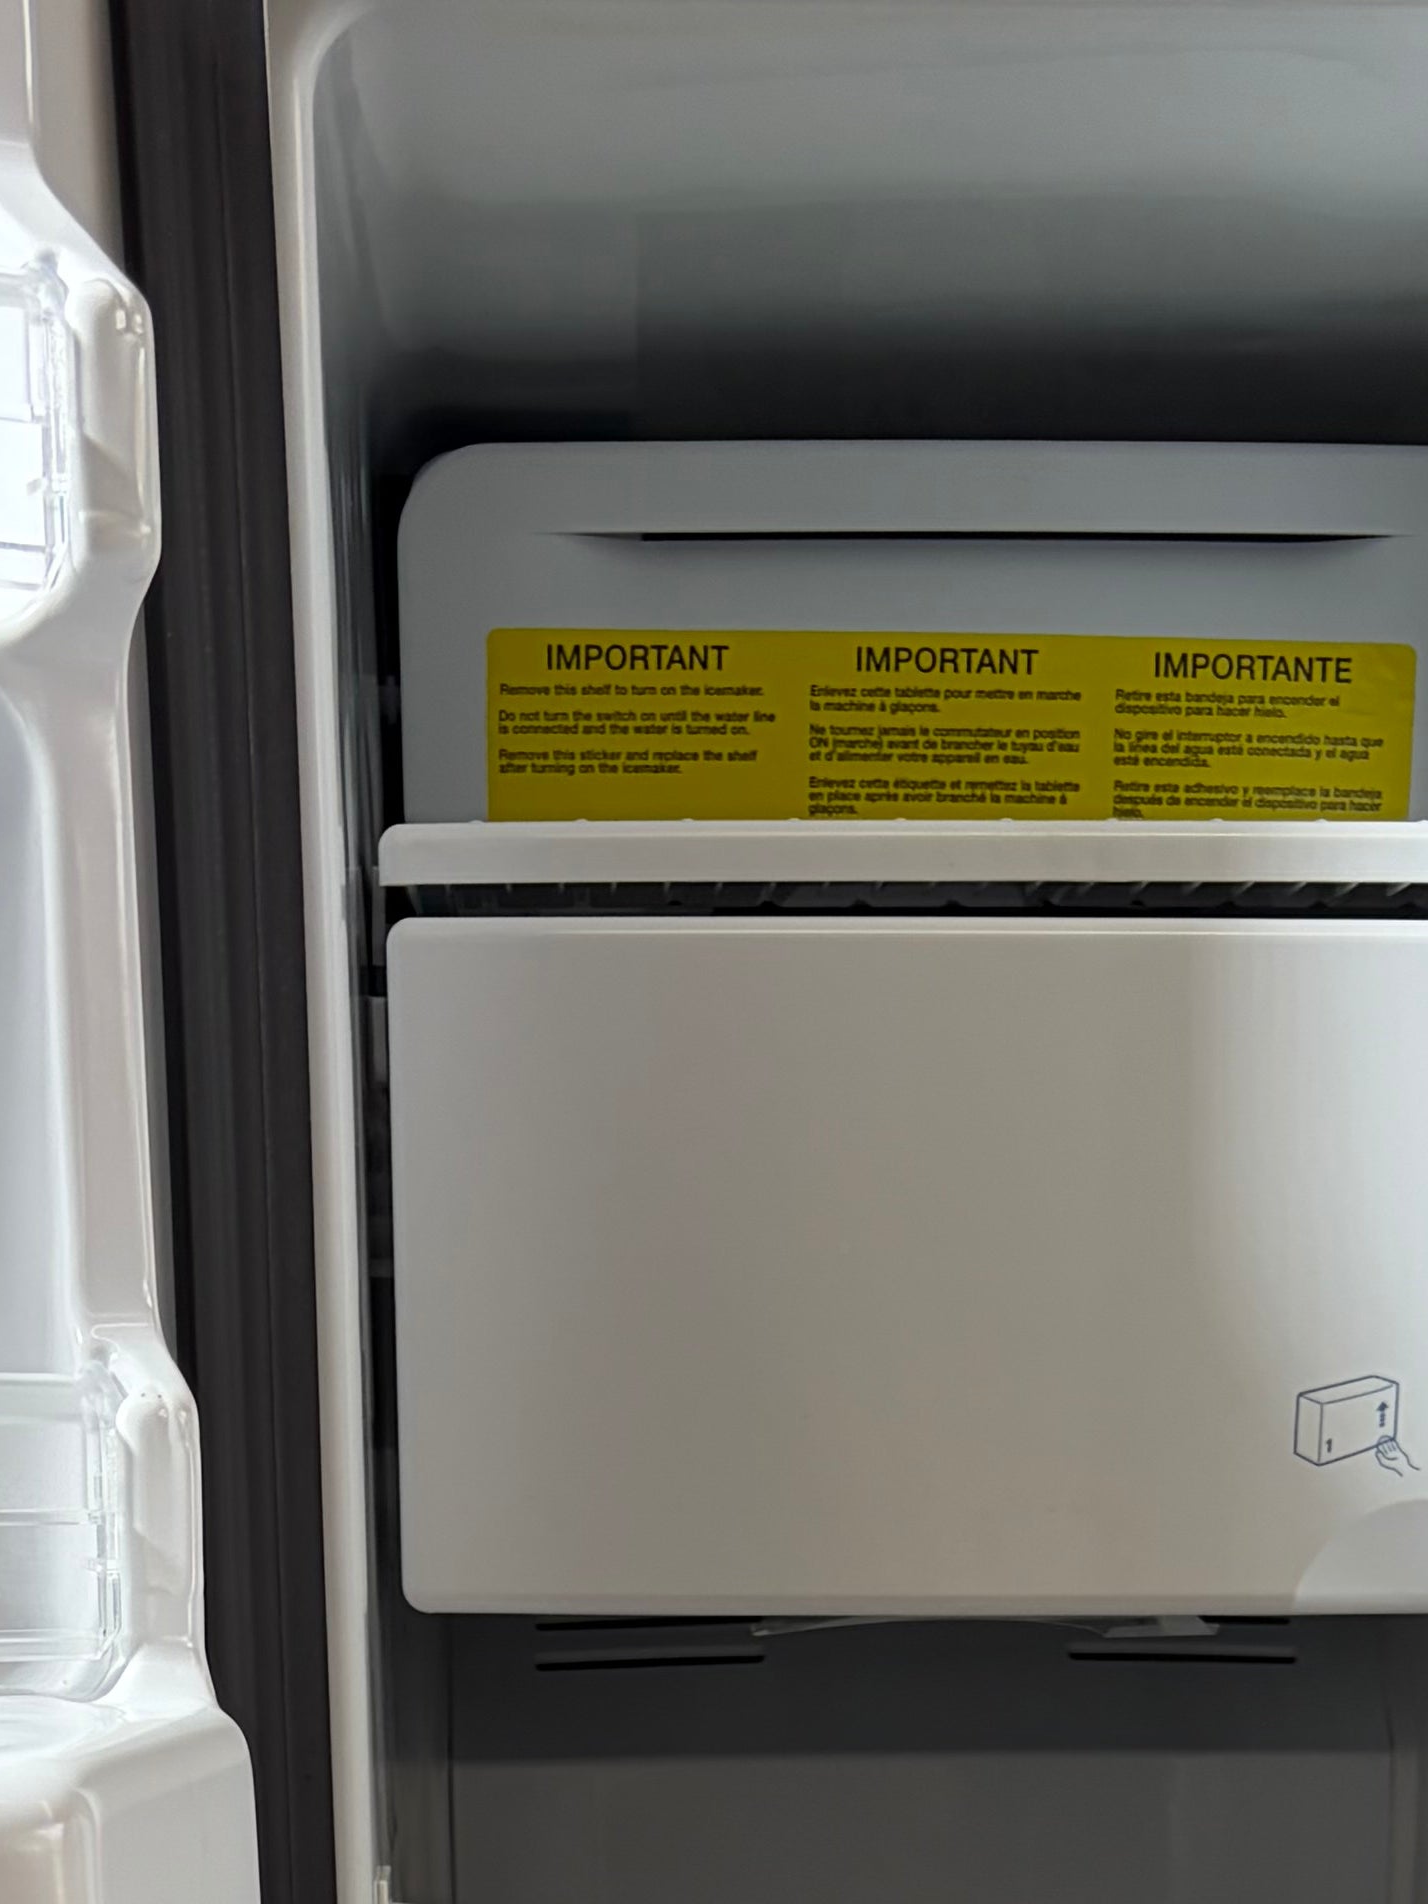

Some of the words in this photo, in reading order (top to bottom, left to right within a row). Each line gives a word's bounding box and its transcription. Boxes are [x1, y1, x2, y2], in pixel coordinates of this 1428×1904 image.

[547, 644, 729, 671] IMPORTANT
[856, 646, 1039, 674] IMPORTANT
[1155, 652, 1352, 683] IMPORTANTE
[500, 684, 550, 695] Remove
[554, 684, 577, 695] this
[581, 684, 610, 695] shelf
[615, 684, 628, 695] to
[632, 684, 656, 695] turn
[660, 686, 676, 695] on
[681, 684, 699, 695] the
[704, 684, 764, 695] icemaker.
[811, 685, 857, 698] Enlevez
[861, 685, 891, 698] cette
[895, 686, 940, 699] tablette
[944, 689, 972, 702] pour
[976, 687, 1014, 699] mettre
[1019, 690, 1033, 700] en
[1037, 688, 1081, 700] marche
[498, 710, 516, 722] Do
[520, 710, 539, 722] not
[544, 710, 568, 722] turn
[573, 710, 592, 722] the
[597, 710, 636, 722] switch
[640, 713, 656, 722] on
[660, 710, 687, 722] until
[691, 710, 710, 722] the
[715, 710, 749, 722] water
[754, 710, 775, 722] line
[499, 724, 509, 735] is
[512, 724, 578, 735] connected
[583, 724, 606, 735] and
[610, 724, 629, 735] the
[633, 724, 667, 735] water
[672, 724, 682, 735] is
[686, 724, 727, 735] turned
[731, 726, 749, 735] on.
[499, 750, 549, 761] Remove
[554, 750, 575, 761] this
[580, 750, 622, 761] sticker
[626, 750, 648, 761] and
[652, 750, 699, 764] replace
[703, 750, 723, 761] the
[727, 750, 757, 761] shelf
[499, 763, 527, 773] after
[532, 763, 575, 776] turning
[579, 765, 594, 773] on
[599, 763, 618, 773] the
[623, 763, 682, 773] icemaker.
[1326, 1439, 1332, 1453] 1
